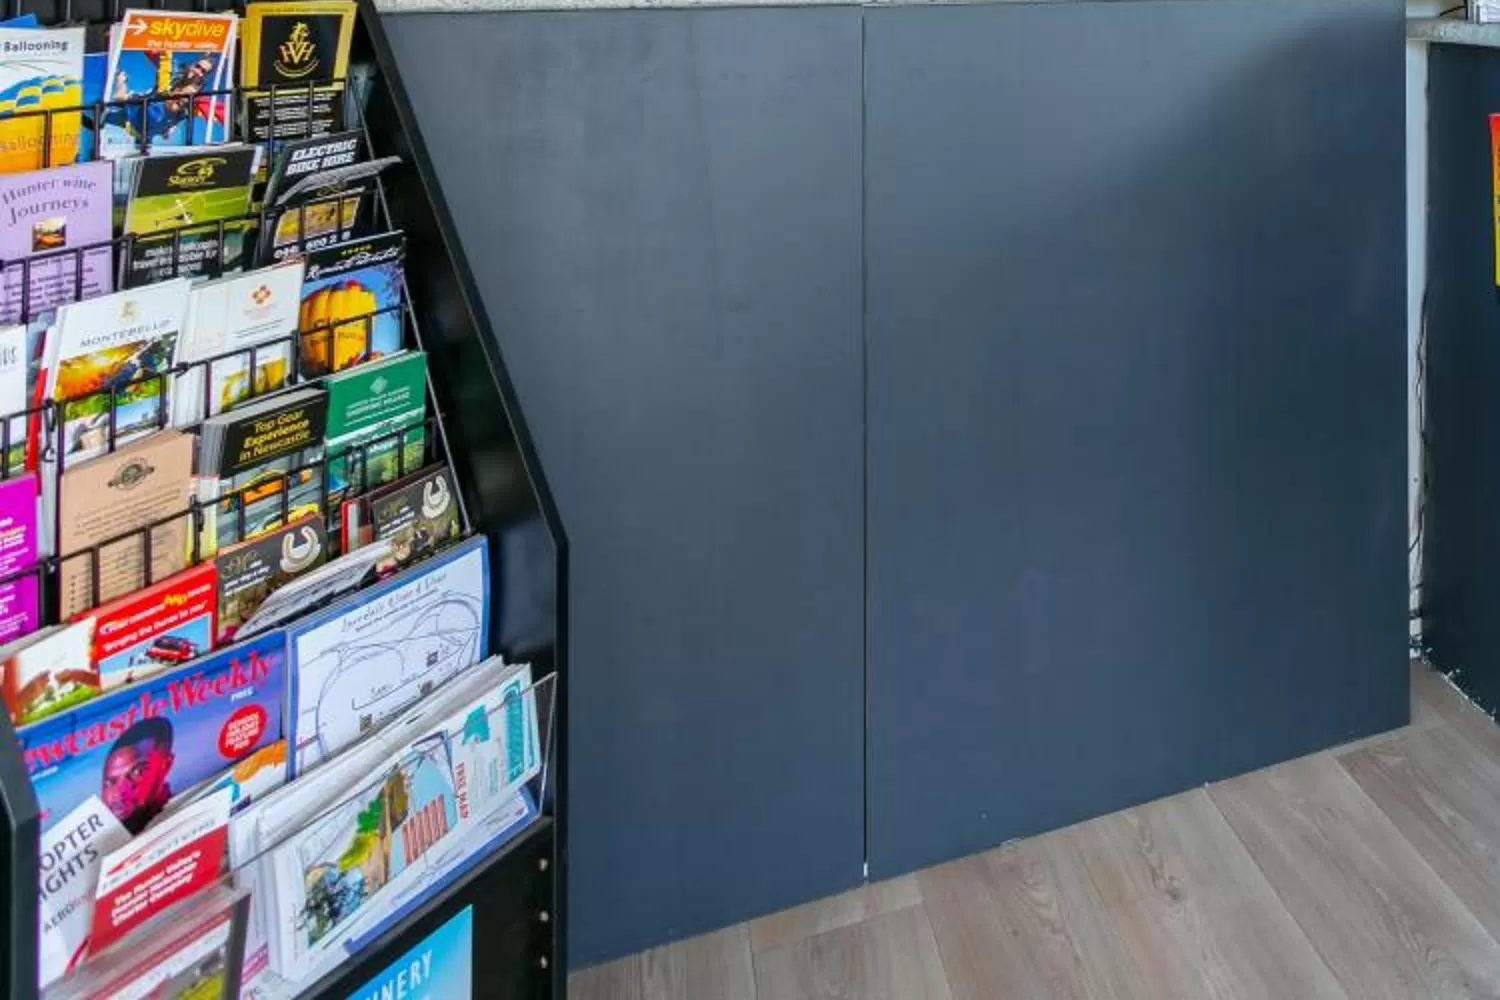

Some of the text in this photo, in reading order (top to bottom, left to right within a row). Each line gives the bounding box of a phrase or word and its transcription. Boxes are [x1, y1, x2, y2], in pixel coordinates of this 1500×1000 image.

[150, 20, 225, 39] skydive
[4, 38, 69, 52] Ballooning
[286, 151, 356, 177] BIKE HIRE
[292, 138, 357, 162] ELECTRIC
[1, 177, 97, 207] Hunter wine
[8, 198, 91, 227] Journeys
[243, 419, 310, 449] Experience
[253, 410, 305, 435] Top Gear
[239, 431, 311, 462] in Newcastle
[167, 652, 275, 713] Weekly
[40, 812, 104, 872] OPTER
